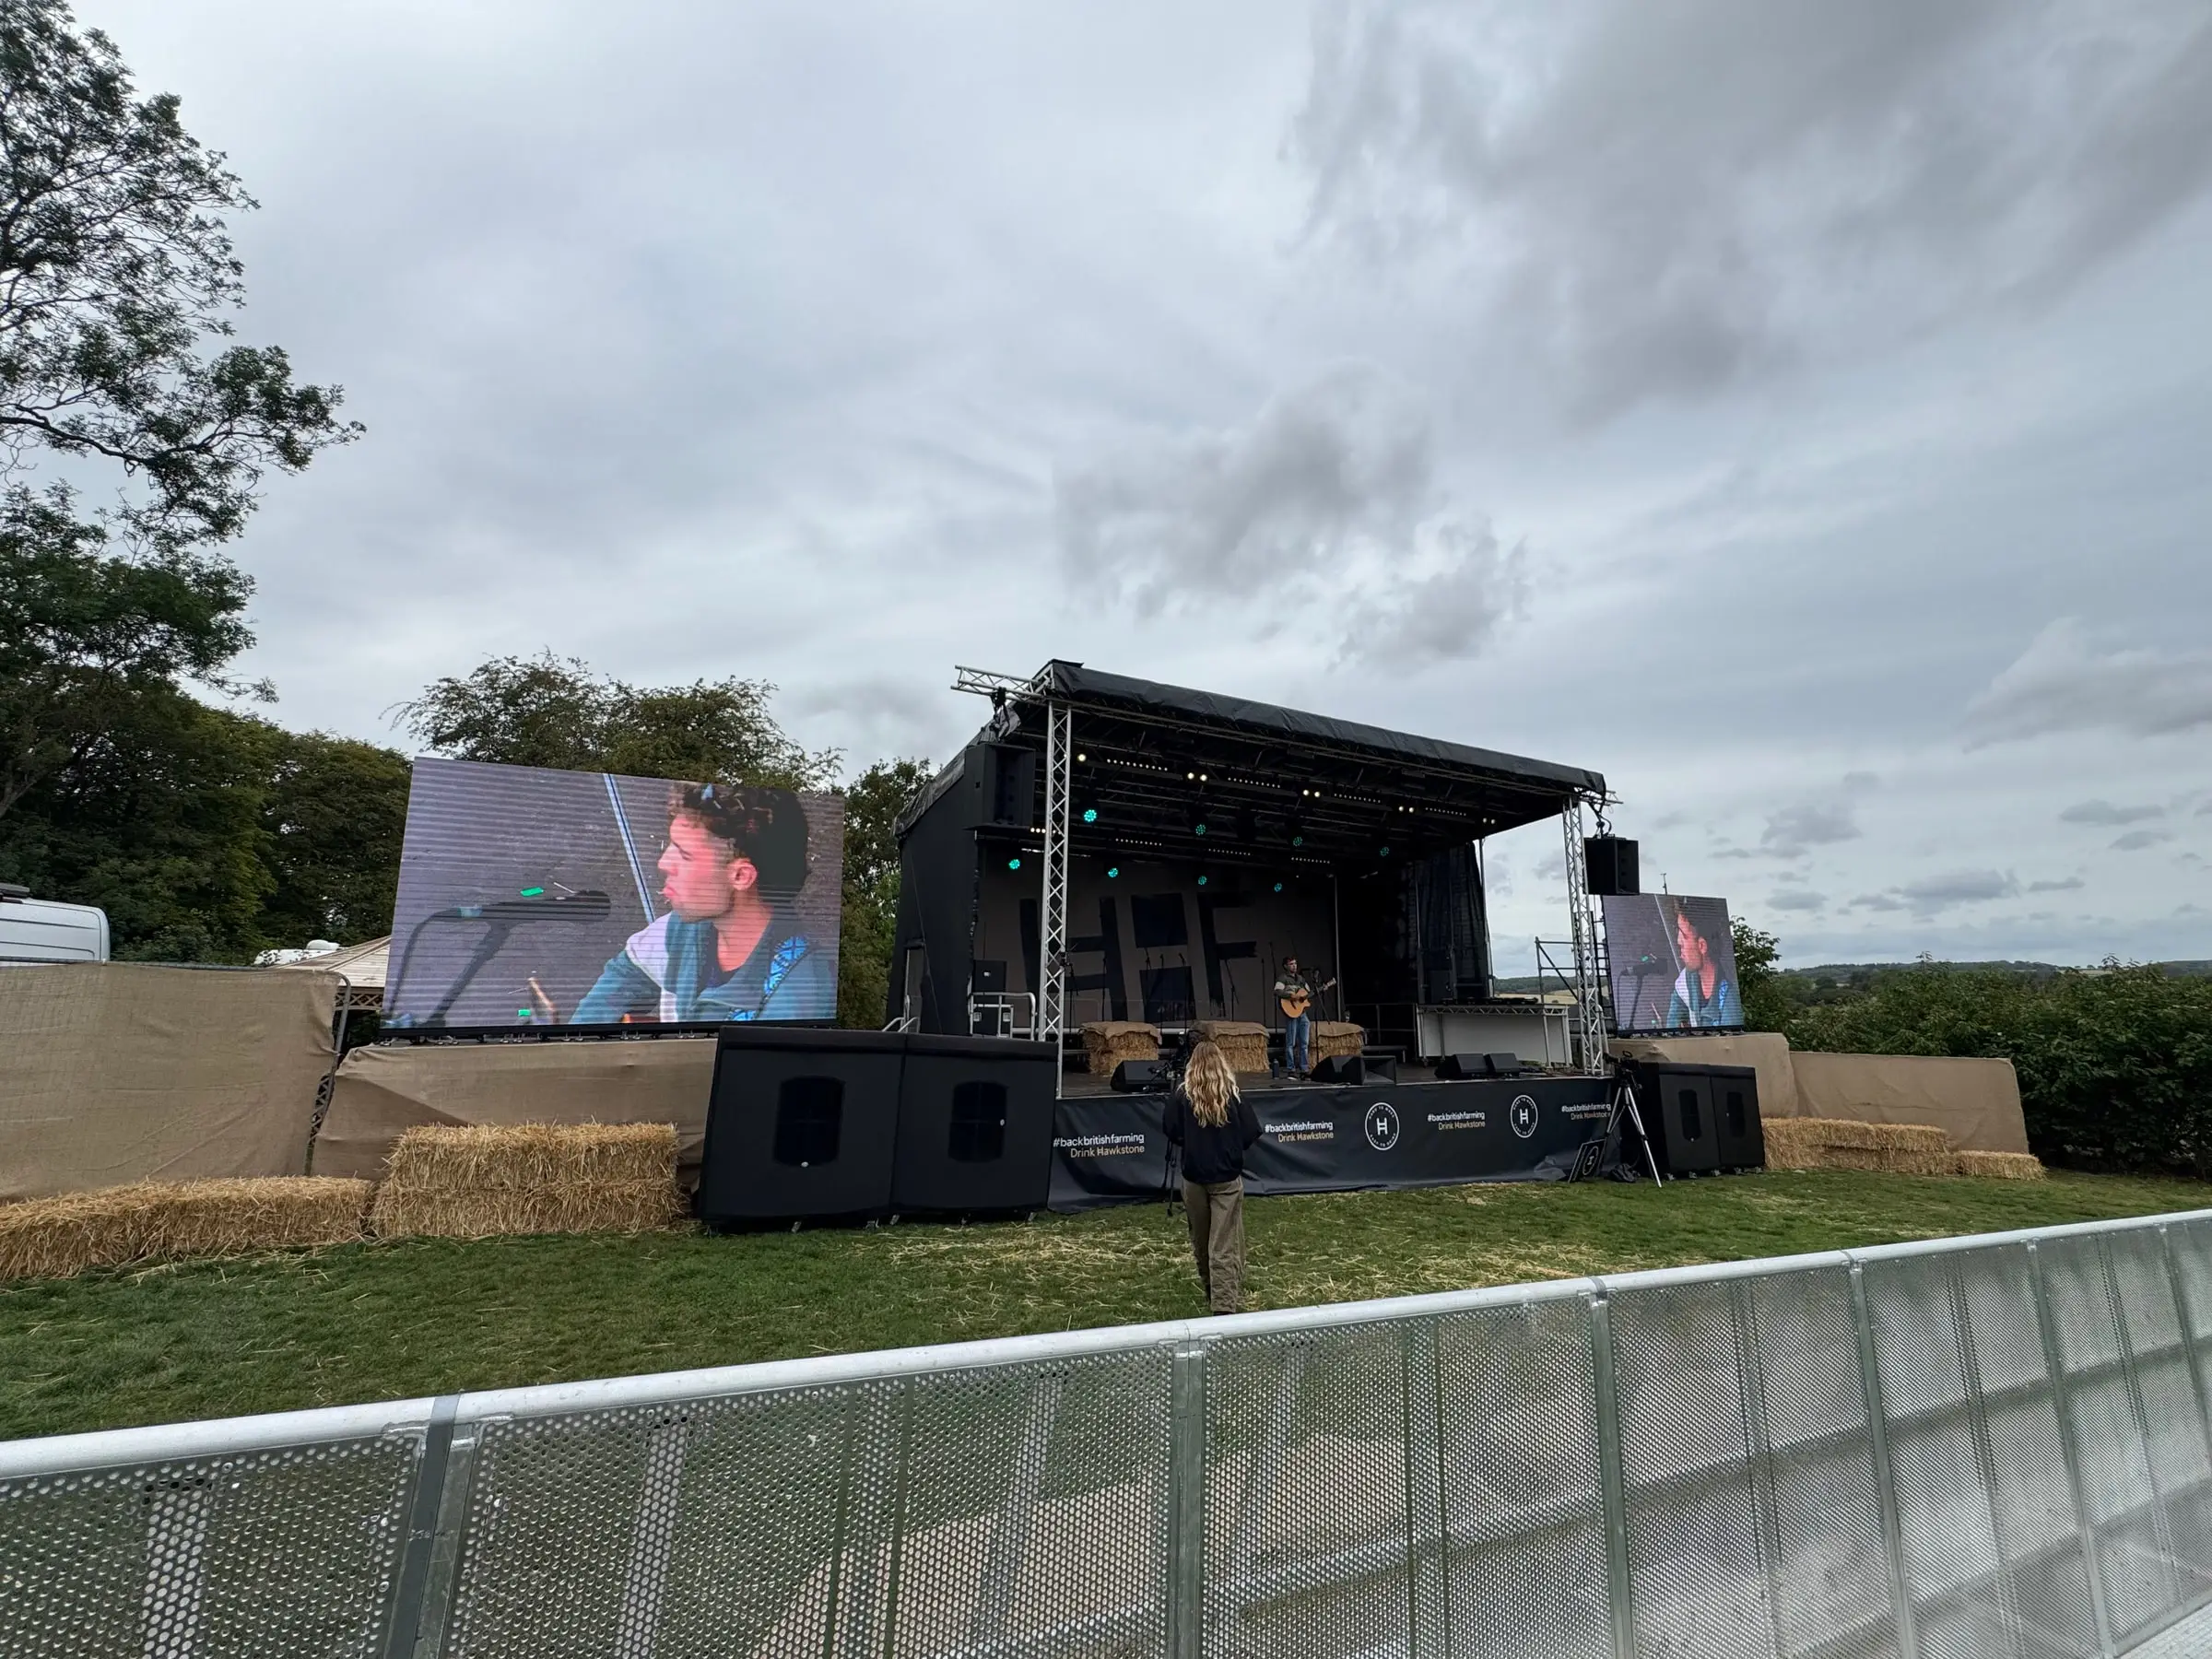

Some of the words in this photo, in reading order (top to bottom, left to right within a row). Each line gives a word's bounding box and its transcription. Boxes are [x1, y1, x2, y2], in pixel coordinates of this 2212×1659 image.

[1428, 1110, 1485, 1122] #backbritishfarming
[1519, 1108, 1529, 1124] H
[1265, 1121, 1333, 1133] #backbritishfarming
[1376, 1117, 1388, 1135] H
[1438, 1122, 1453, 1130] Drink
[1454, 1120, 1485, 1129] Hawkstone
[1053, 1132, 1145, 1147] #backbritishfarming
[1277, 1133, 1296, 1142] Drink
[1297, 1131, 1334, 1141] Hawkstone
[1070, 1147, 1096, 1158] Drink
[1097, 1144, 1145, 1156] Hawkstone
